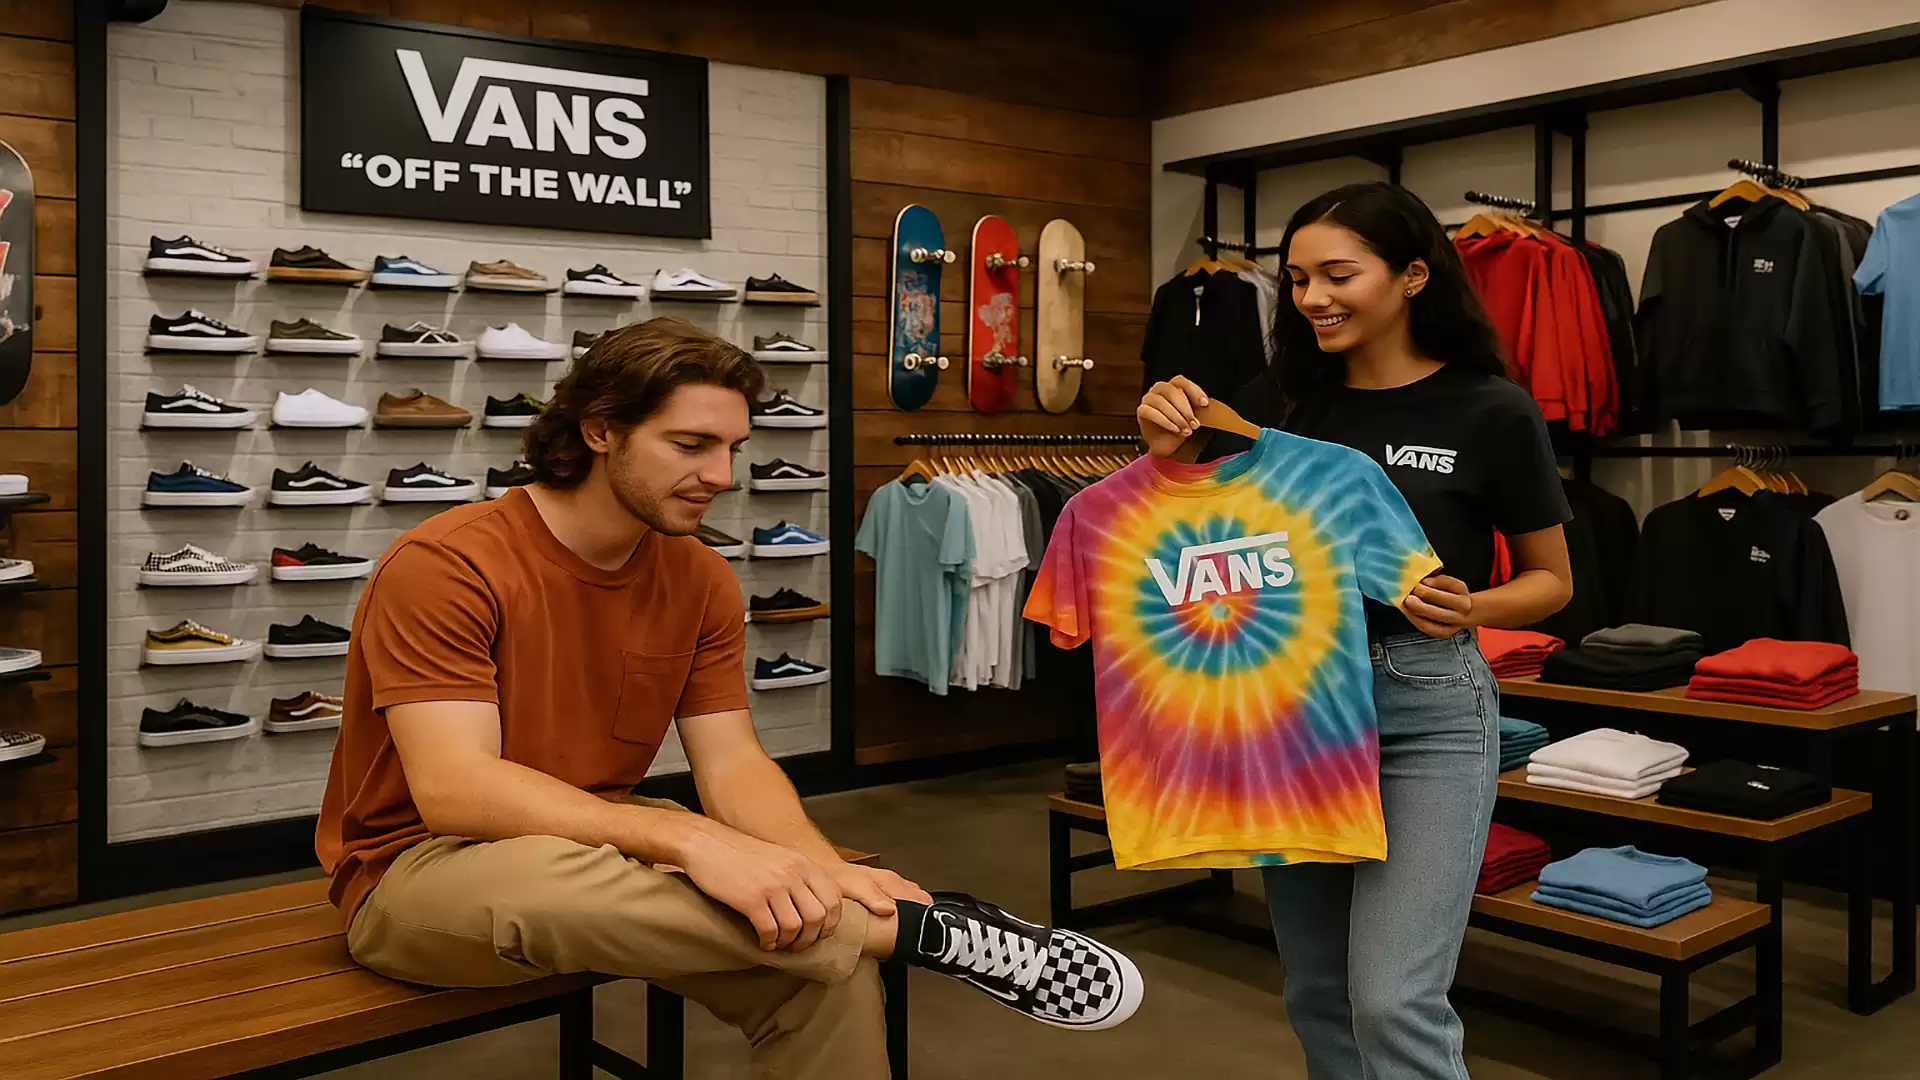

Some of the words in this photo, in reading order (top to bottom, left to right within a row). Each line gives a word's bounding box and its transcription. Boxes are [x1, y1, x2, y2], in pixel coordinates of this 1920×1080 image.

[396, 49, 649, 159] VANS
[470, 163, 559, 199] THE
[1386, 444, 1457, 474] VANS
[1145, 531, 1295, 606] VANS
